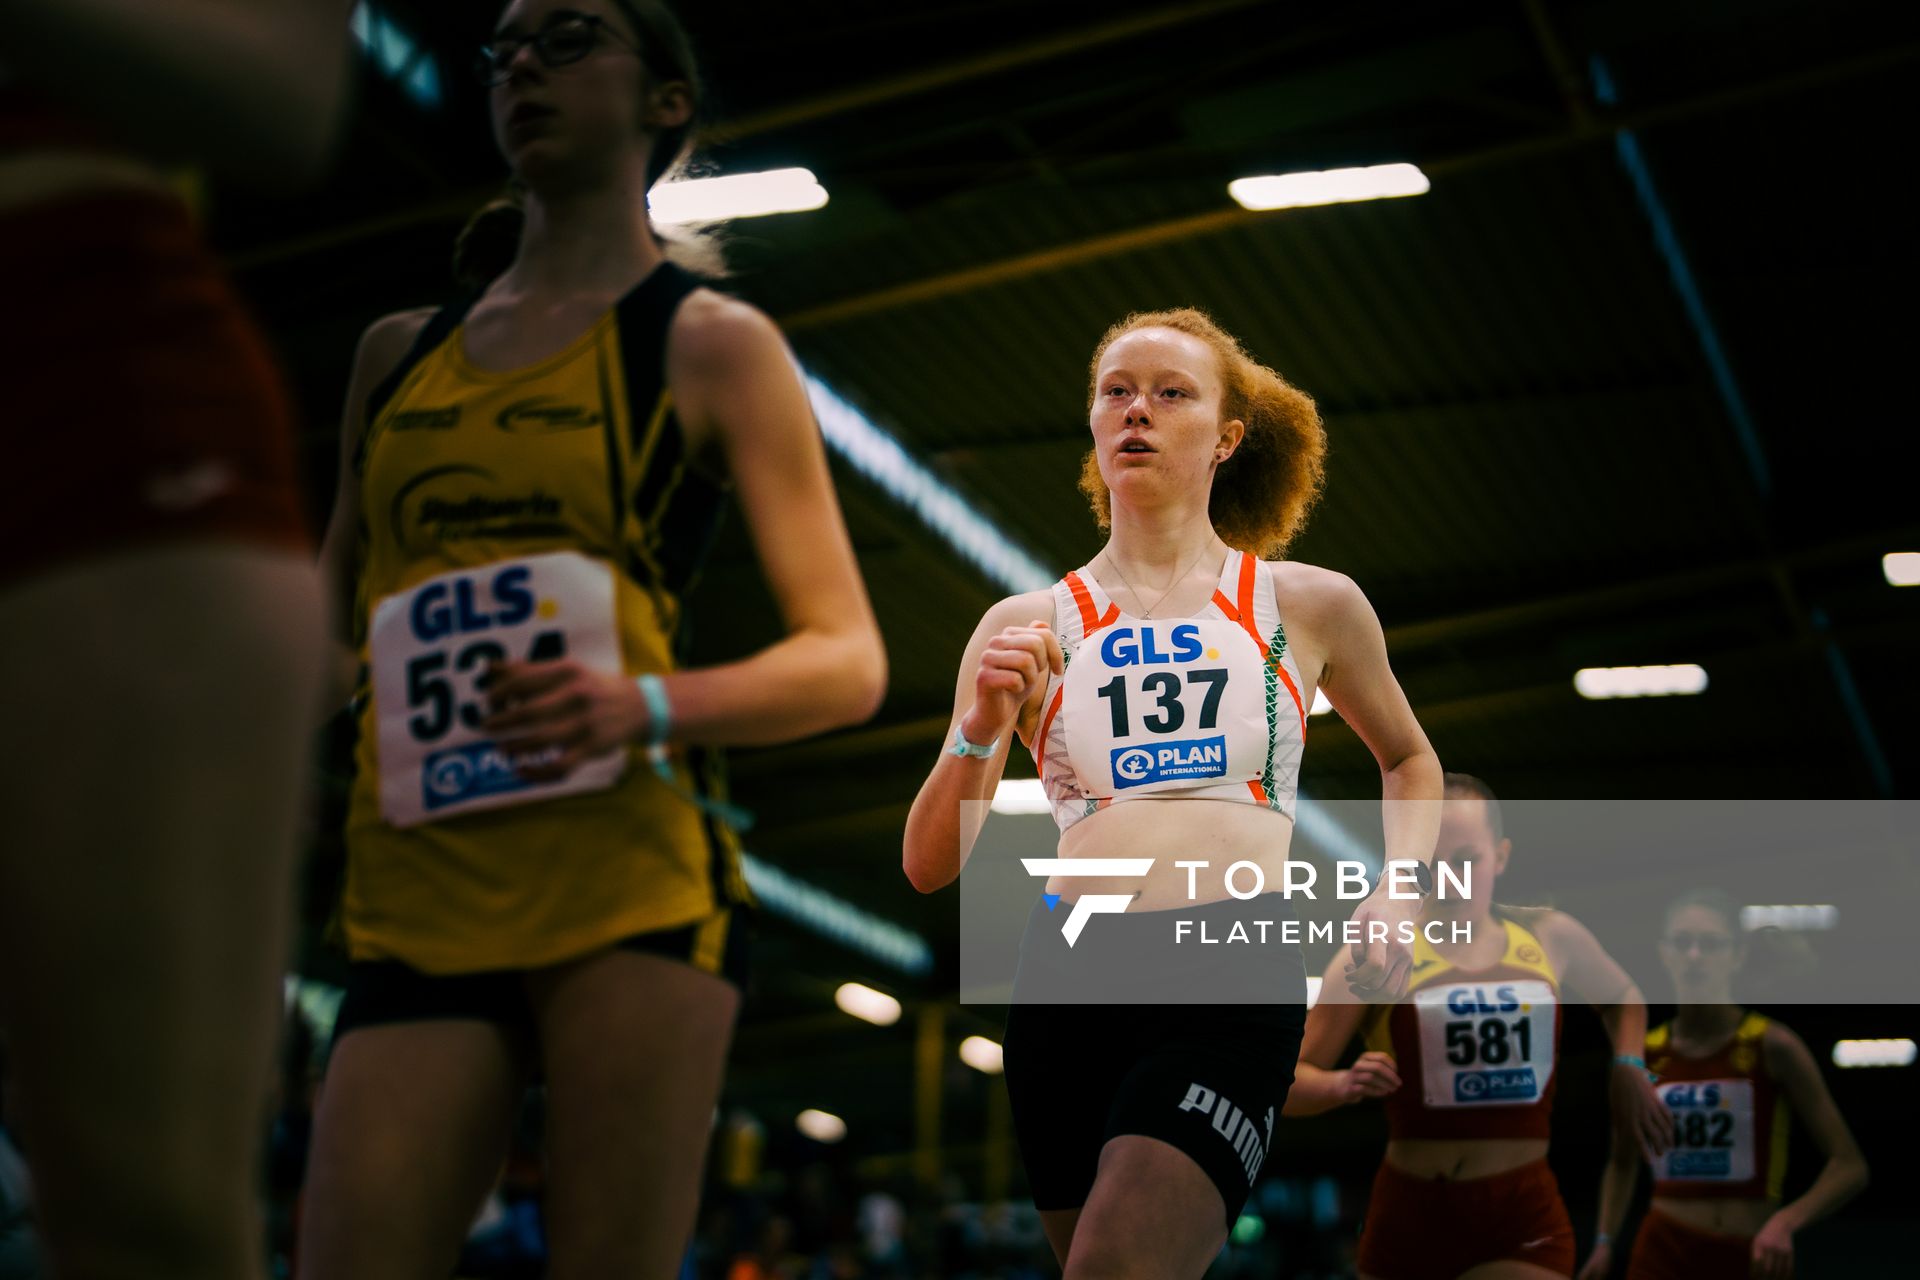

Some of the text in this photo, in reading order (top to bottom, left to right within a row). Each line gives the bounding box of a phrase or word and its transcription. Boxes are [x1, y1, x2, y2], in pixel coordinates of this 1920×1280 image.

[407, 629, 566, 741] 53
[1097, 668, 1229, 738] 137
[1158, 744, 1222, 767] PLAN
[1159, 766, 1222, 777] INTERNATIONAL
[1445, 1016, 1532, 1066] 581
[1177, 1082, 1264, 1188] PUMA
